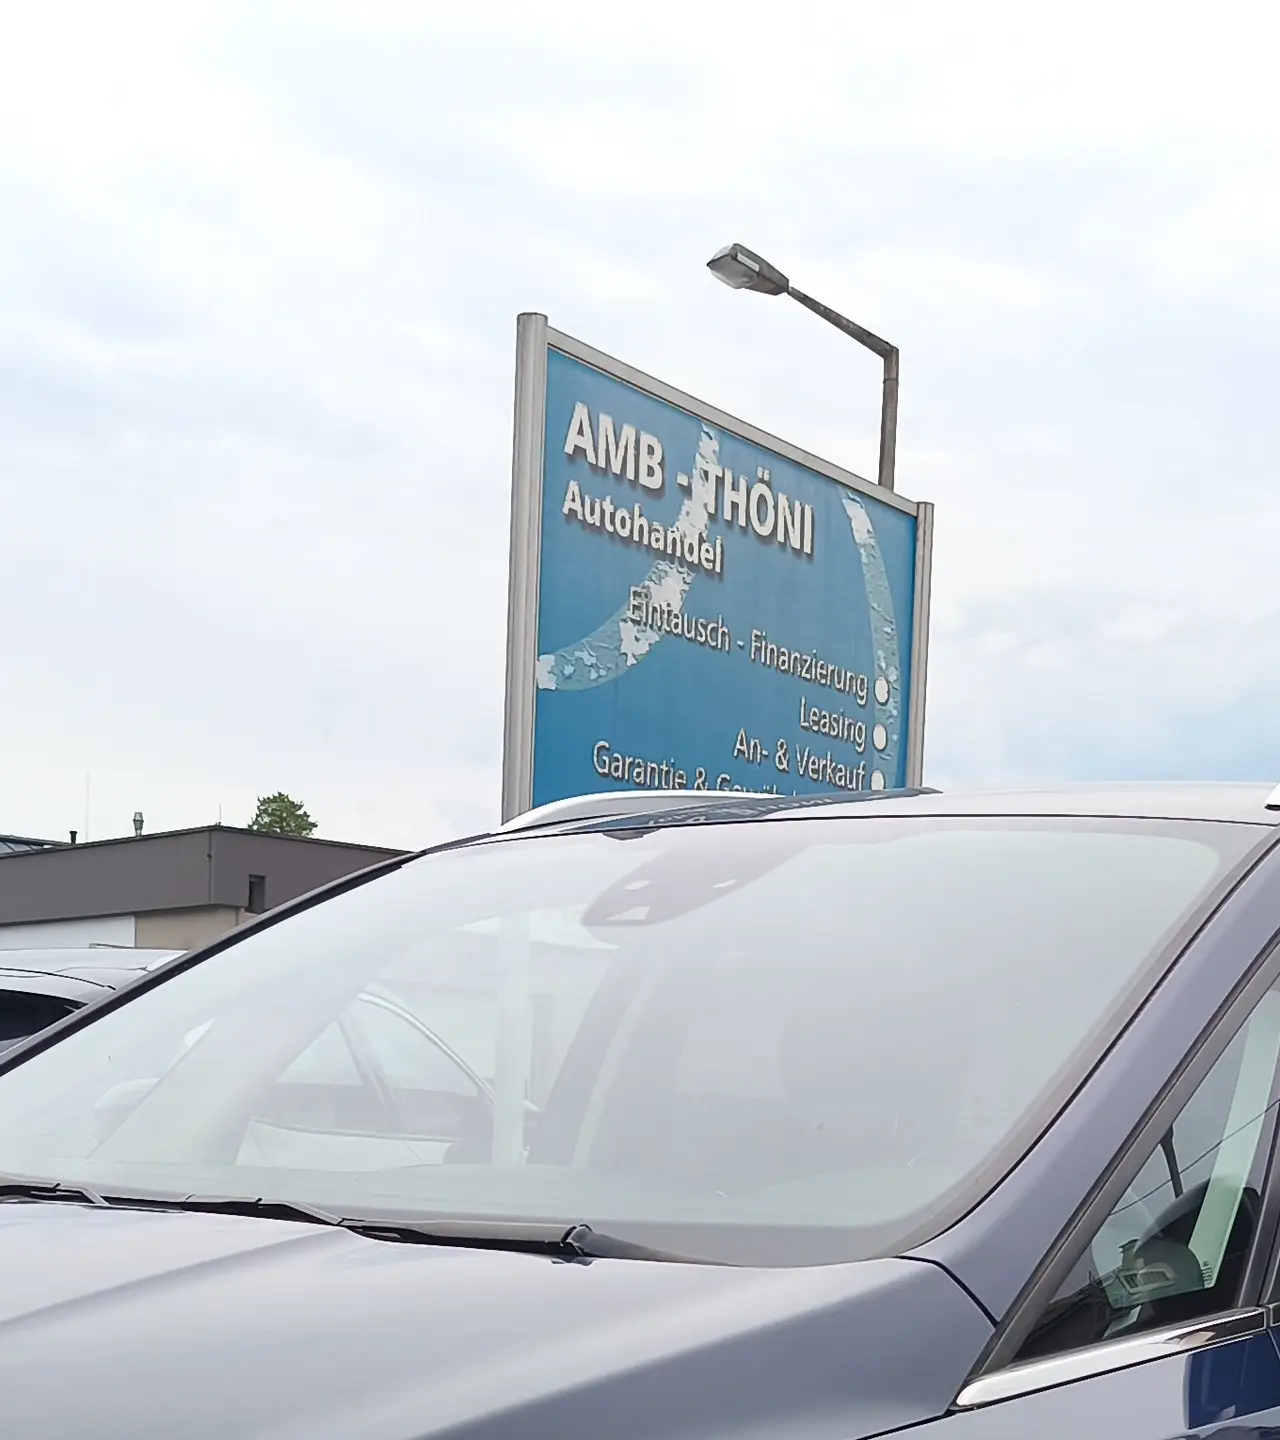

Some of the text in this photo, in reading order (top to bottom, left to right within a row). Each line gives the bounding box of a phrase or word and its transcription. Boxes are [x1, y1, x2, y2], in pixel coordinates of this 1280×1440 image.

[564, 401, 664, 490] AMB
[700, 460, 814, 555] THÖNI
[562, 479, 724, 573] Autohandel
[628, 585, 731, 652] Eintausch
[750, 627, 869, 705] Finanzierung
[733, 727, 769, 763] An-
[775, 738, 790, 772] &
[796, 744, 866, 790] Verkauf
[799, 696, 866, 752] Leasing
[593, 740, 687, 790] Garantie
